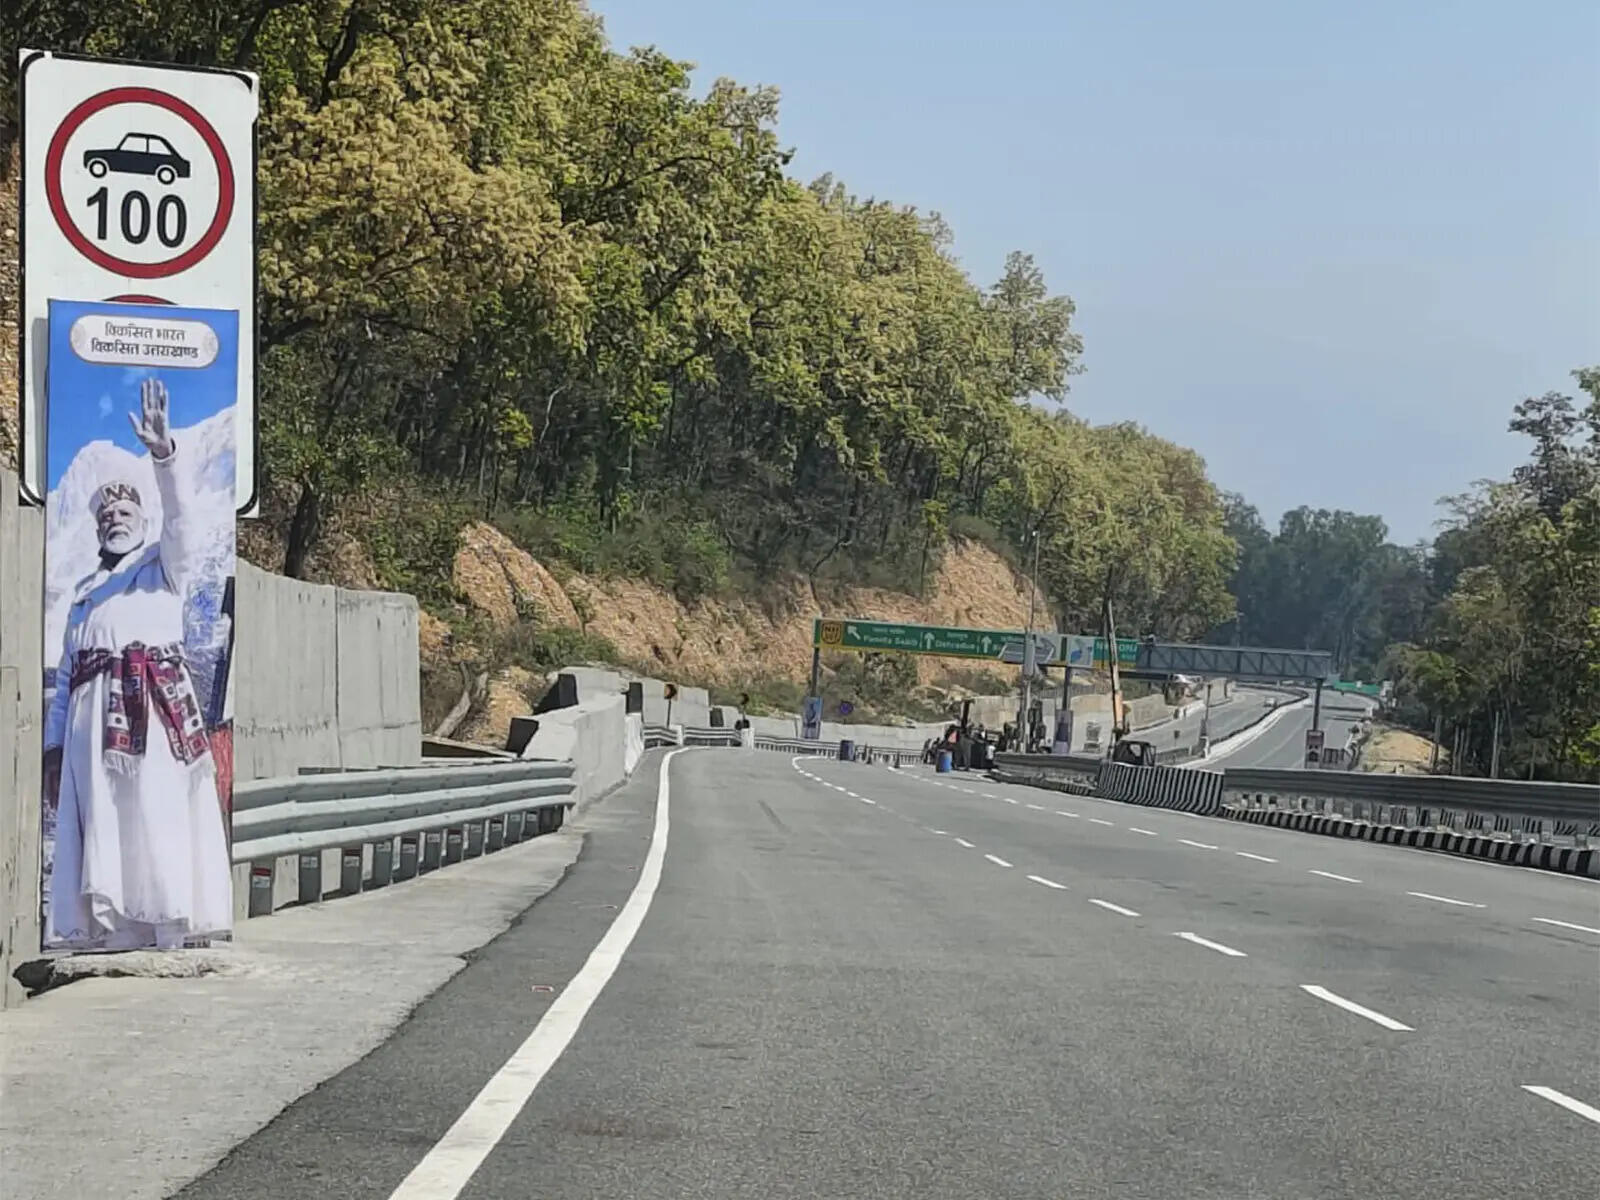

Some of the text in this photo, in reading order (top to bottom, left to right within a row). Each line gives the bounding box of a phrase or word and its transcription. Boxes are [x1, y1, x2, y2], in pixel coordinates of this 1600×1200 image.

[86, 187, 187, 248] 100
[156, 327, 185, 341] भारत
[91, 338, 140, 355] विकसित
